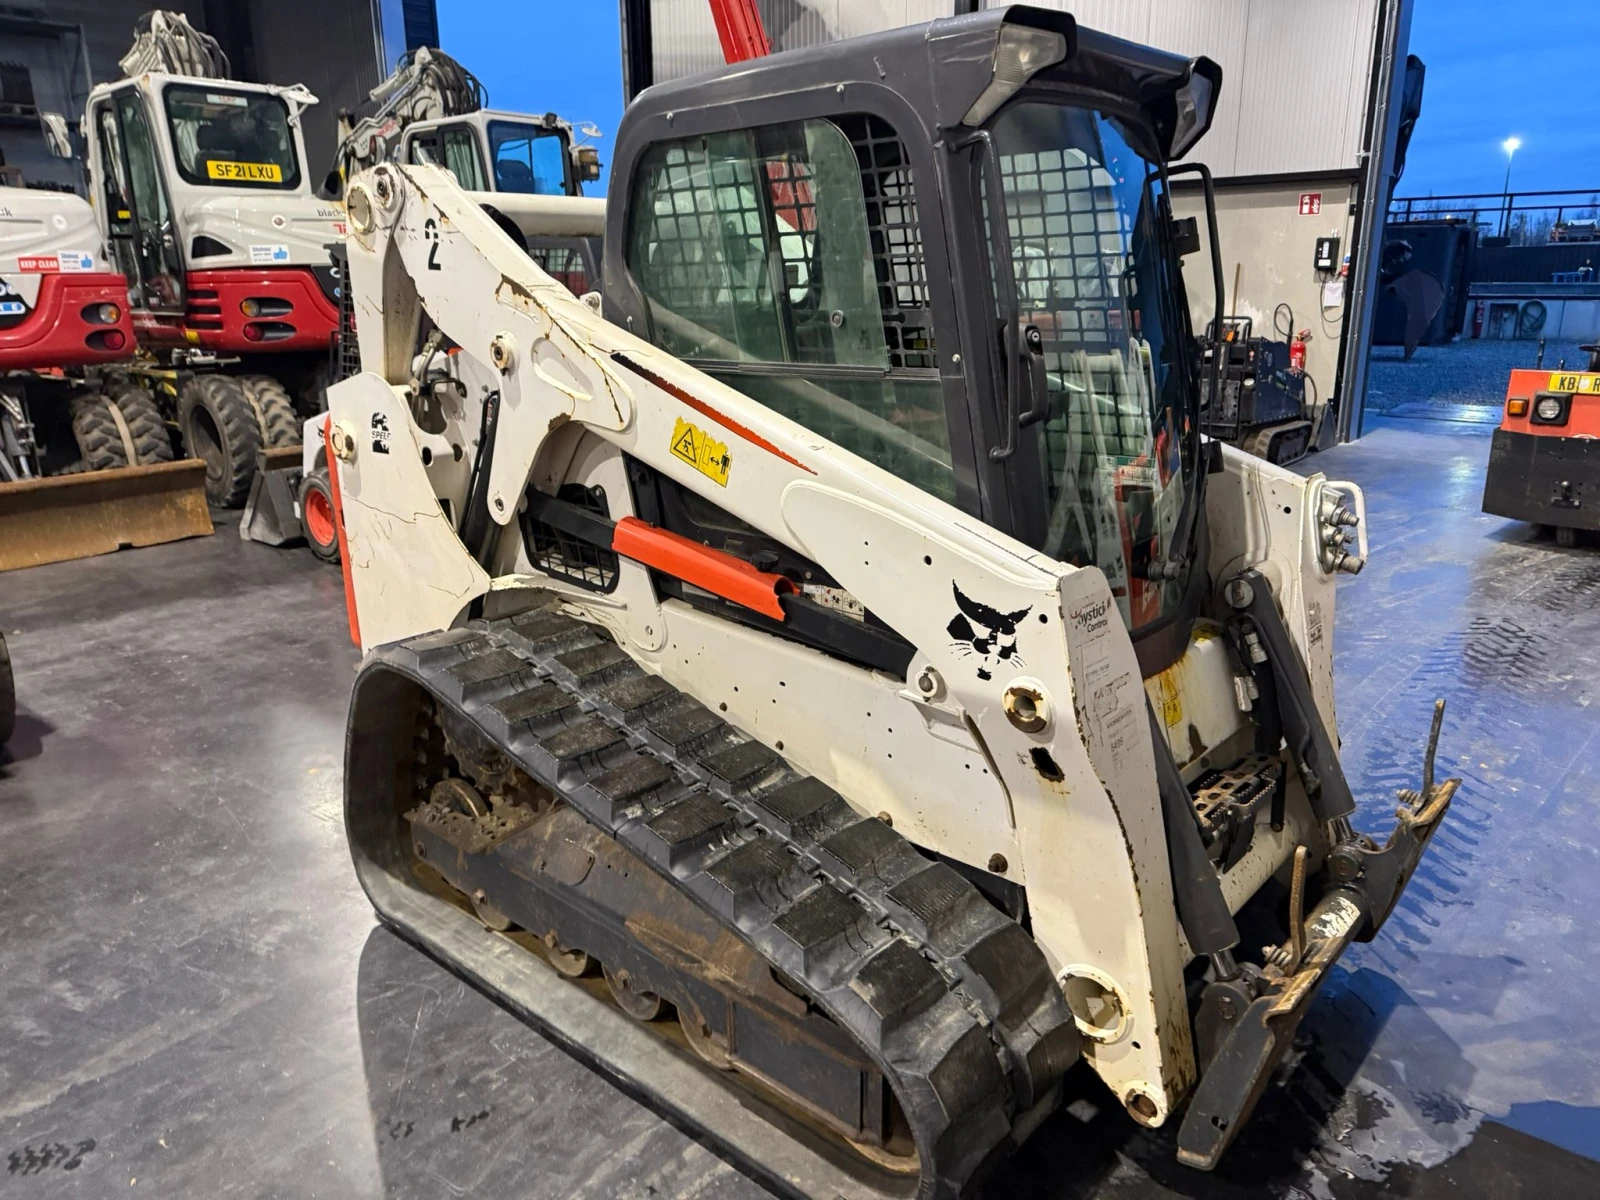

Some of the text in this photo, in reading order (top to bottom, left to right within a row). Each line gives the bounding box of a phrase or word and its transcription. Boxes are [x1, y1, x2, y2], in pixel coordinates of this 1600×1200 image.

[216, 164, 274, 179] SF21 LXU
[317, 209, 346, 218] black
[425, 218, 441, 271] 2
[20, 260, 37, 269] KEEP
[38, 260, 58, 269] CLEAR
[1559, 376, 1576, 391] KB
